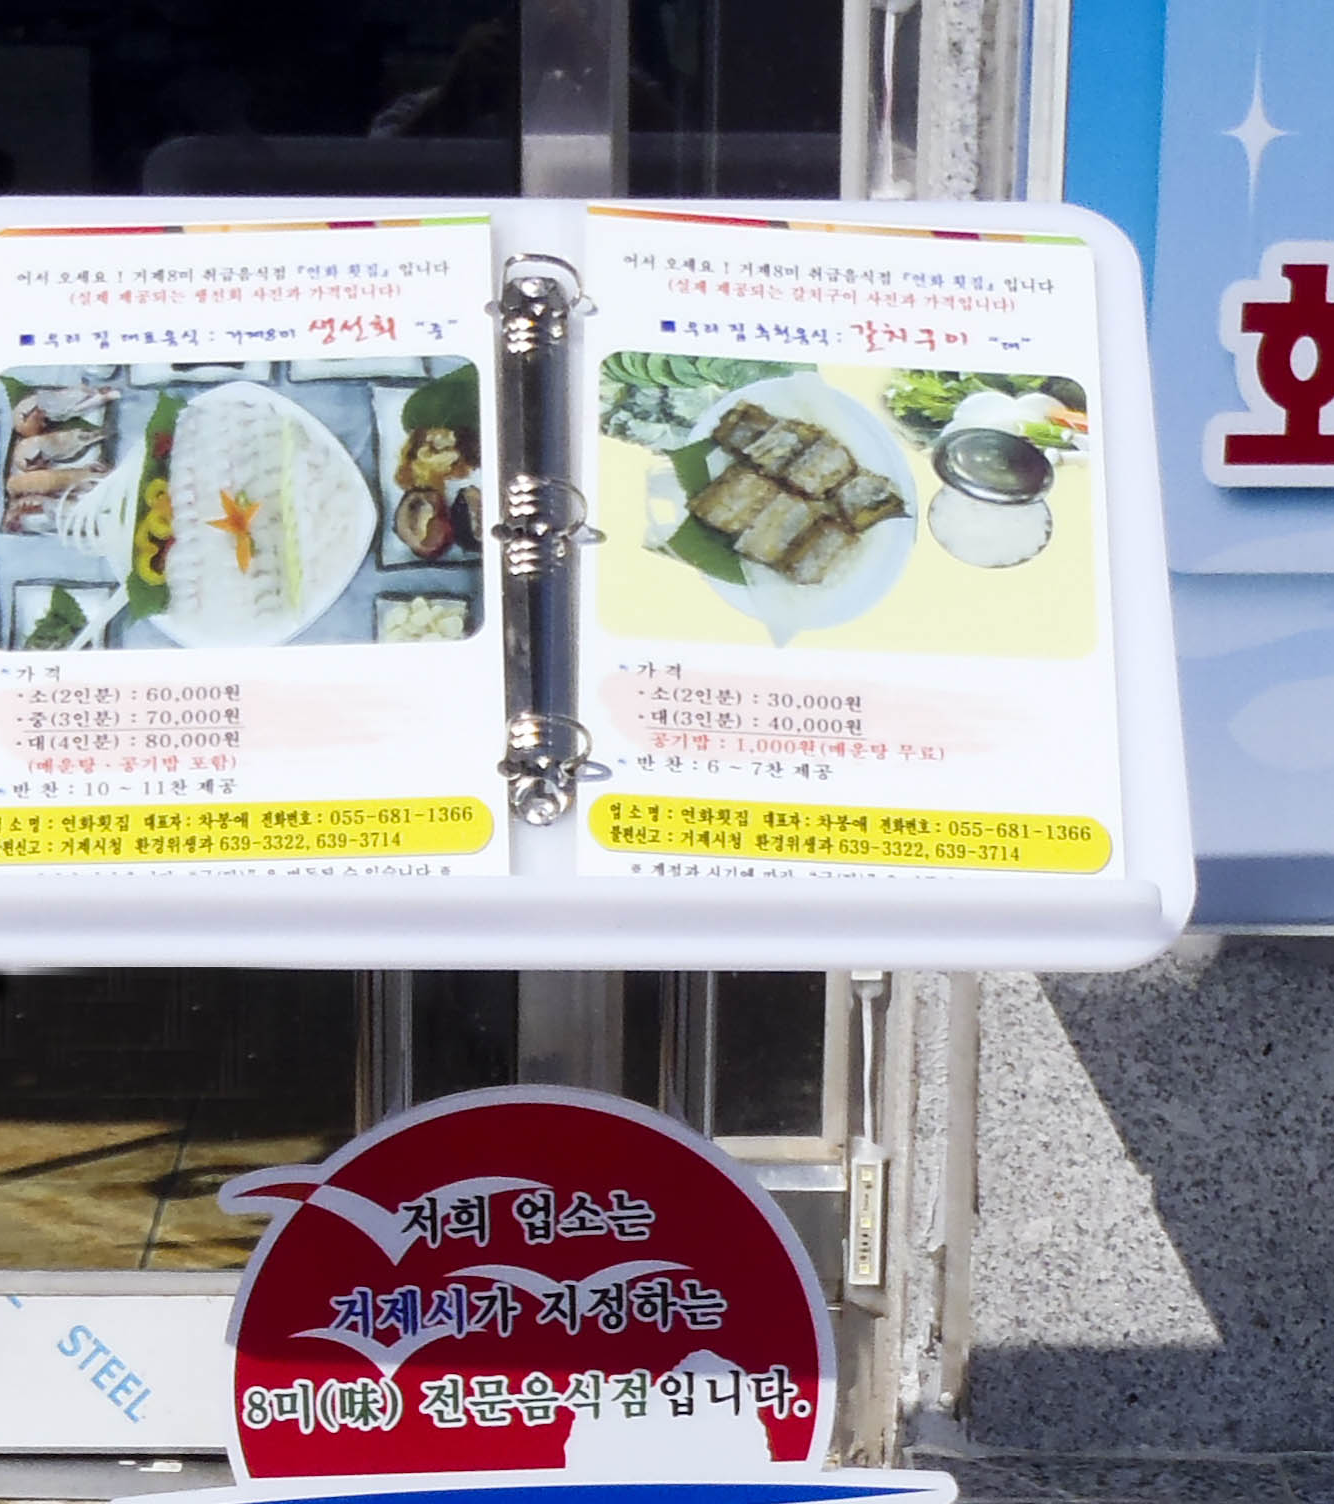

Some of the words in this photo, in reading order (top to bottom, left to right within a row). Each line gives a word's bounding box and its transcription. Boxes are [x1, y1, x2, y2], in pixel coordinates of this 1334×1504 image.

[399, 260, 449, 277] 입니다
[1004, 277, 1054, 294] 입니다
[308, 314, 397, 345] 생선회
[850, 320, 968, 352] 갈치구이
[146, 684, 240, 702] 60,000원
[767, 692, 862, 713] 30,000원
[146, 708, 240, 725] 70,000원
[768, 716, 862, 736] 40,000원
[146, 731, 240, 749] 80,000원
[61, 814, 130, 833] 연화횟집
[330, 806, 473, 826] 055-681-1366
[681, 806, 749, 827] 연화횟집
[949, 821, 1092, 842] 055-681-1366
[61, 837, 122, 856] 거제시청
[135, 836, 213, 855] 환경위생과
[317, 832, 401, 849] 639-3714
[610, 825, 661, 844] 불편신고
[681, 830, 742, 849] 거제시청
[755, 834, 833, 854] 환경위생과
[935, 844, 1020, 862] 639-3714
[399, 1192, 490, 1248] 저희
[513, 1190, 655, 1243] 업소는
[328, 1282, 518, 1338] 거제시가
[538, 1279, 727, 1335] 지정하는
[57, 1324, 151, 1423] STEEL
[243, 1377, 402, 1433] 8미(味)
[421, 1366, 812, 1427] 전문음식점입니다.
